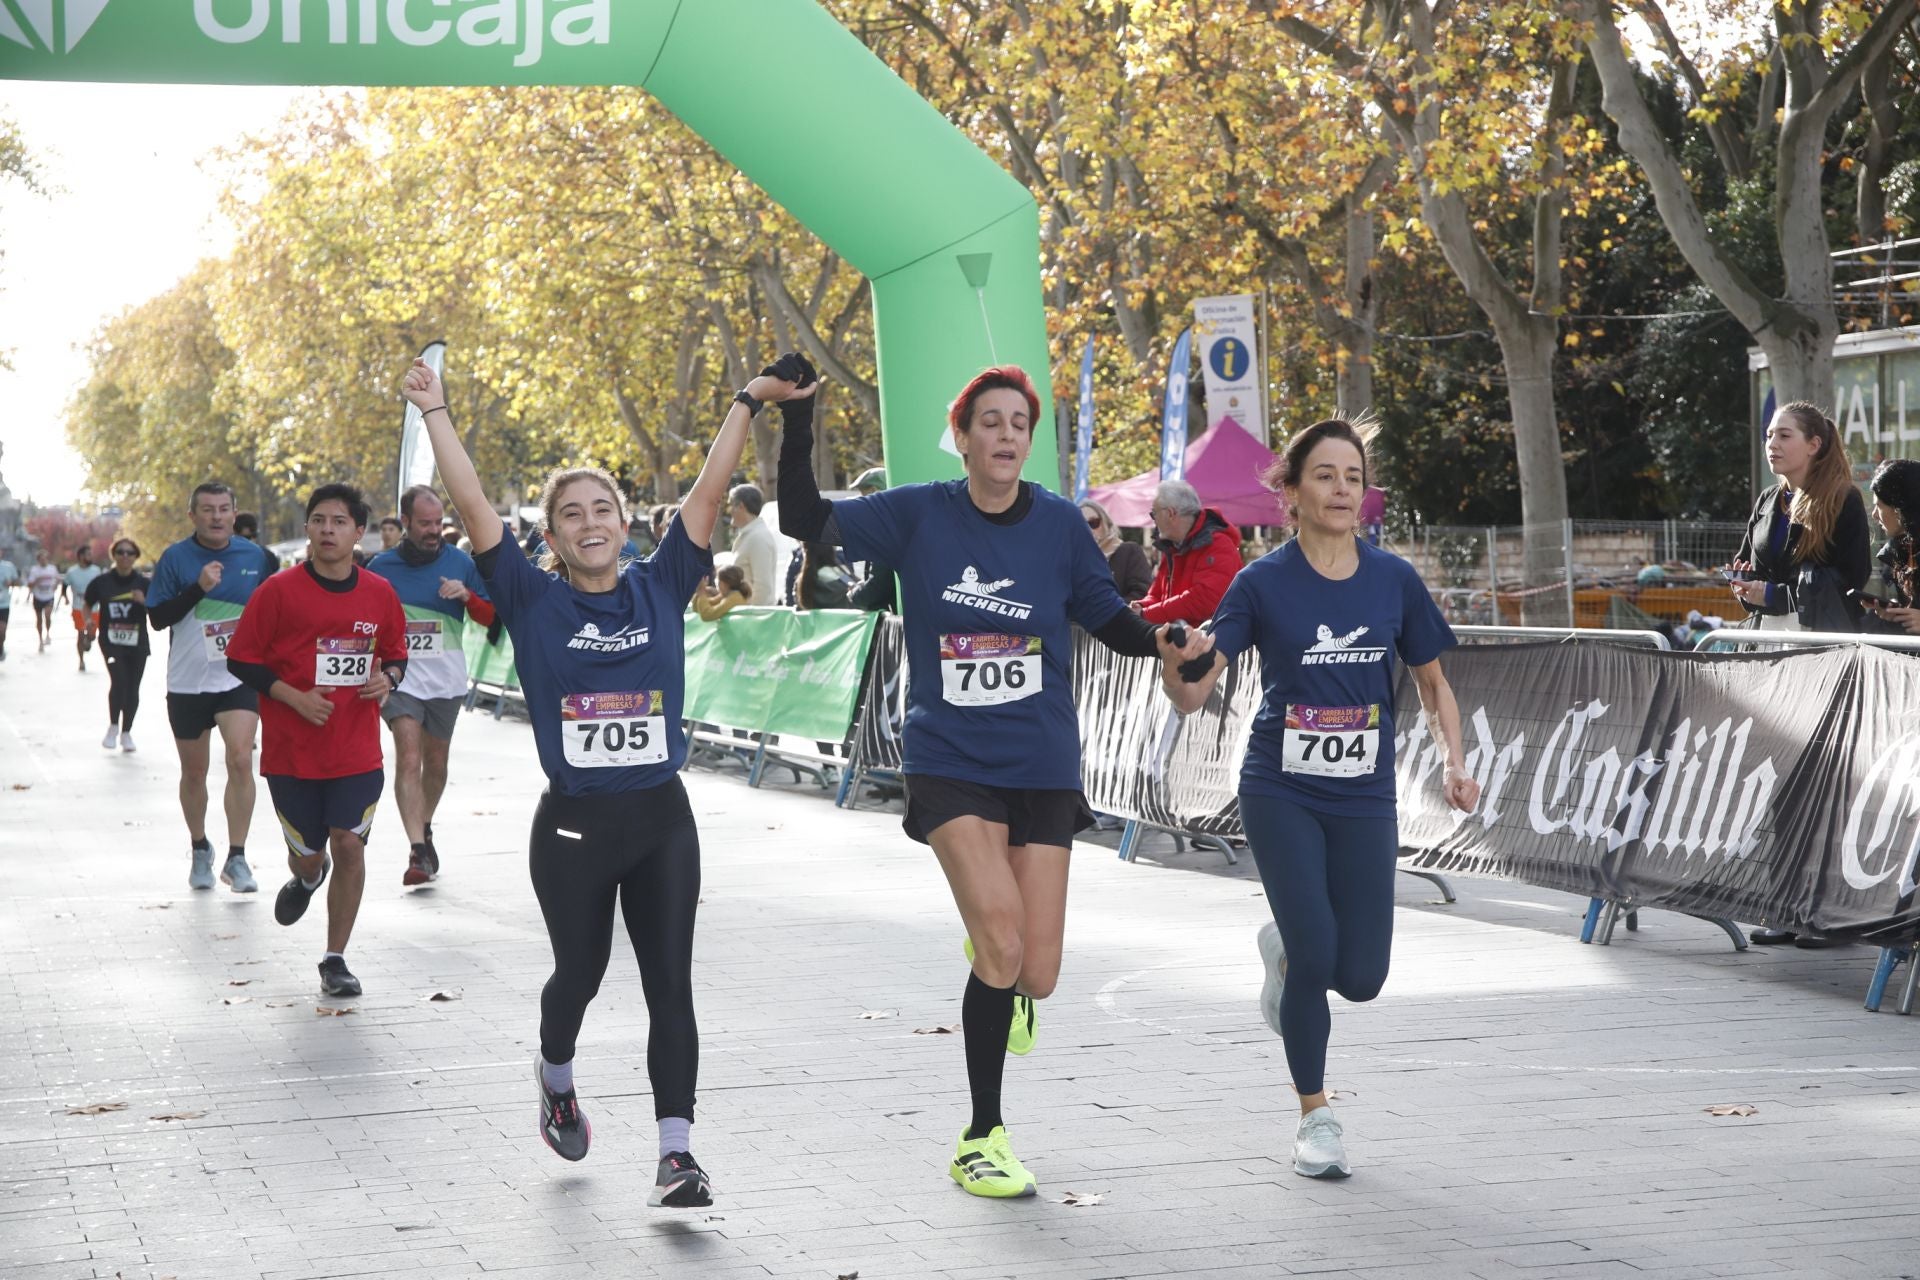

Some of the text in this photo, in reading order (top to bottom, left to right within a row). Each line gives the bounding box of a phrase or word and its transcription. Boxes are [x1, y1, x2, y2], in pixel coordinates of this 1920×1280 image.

[108, 602, 132, 618] EY
[942, 590, 1031, 620] MICHELIN
[972, 635, 1000, 643] CARRERA
[972, 641, 1009, 650] EMPRESAS
[1301, 651, 1385, 665] MICHELIN
[326, 657, 367, 676] 328
[955, 660, 1026, 691] 706
[596, 701, 633, 710] EMPRESAS
[1318, 715, 1353, 724] EMPRESAS
[577, 720, 650, 752] 705
[1298, 733, 1367, 763] 704
